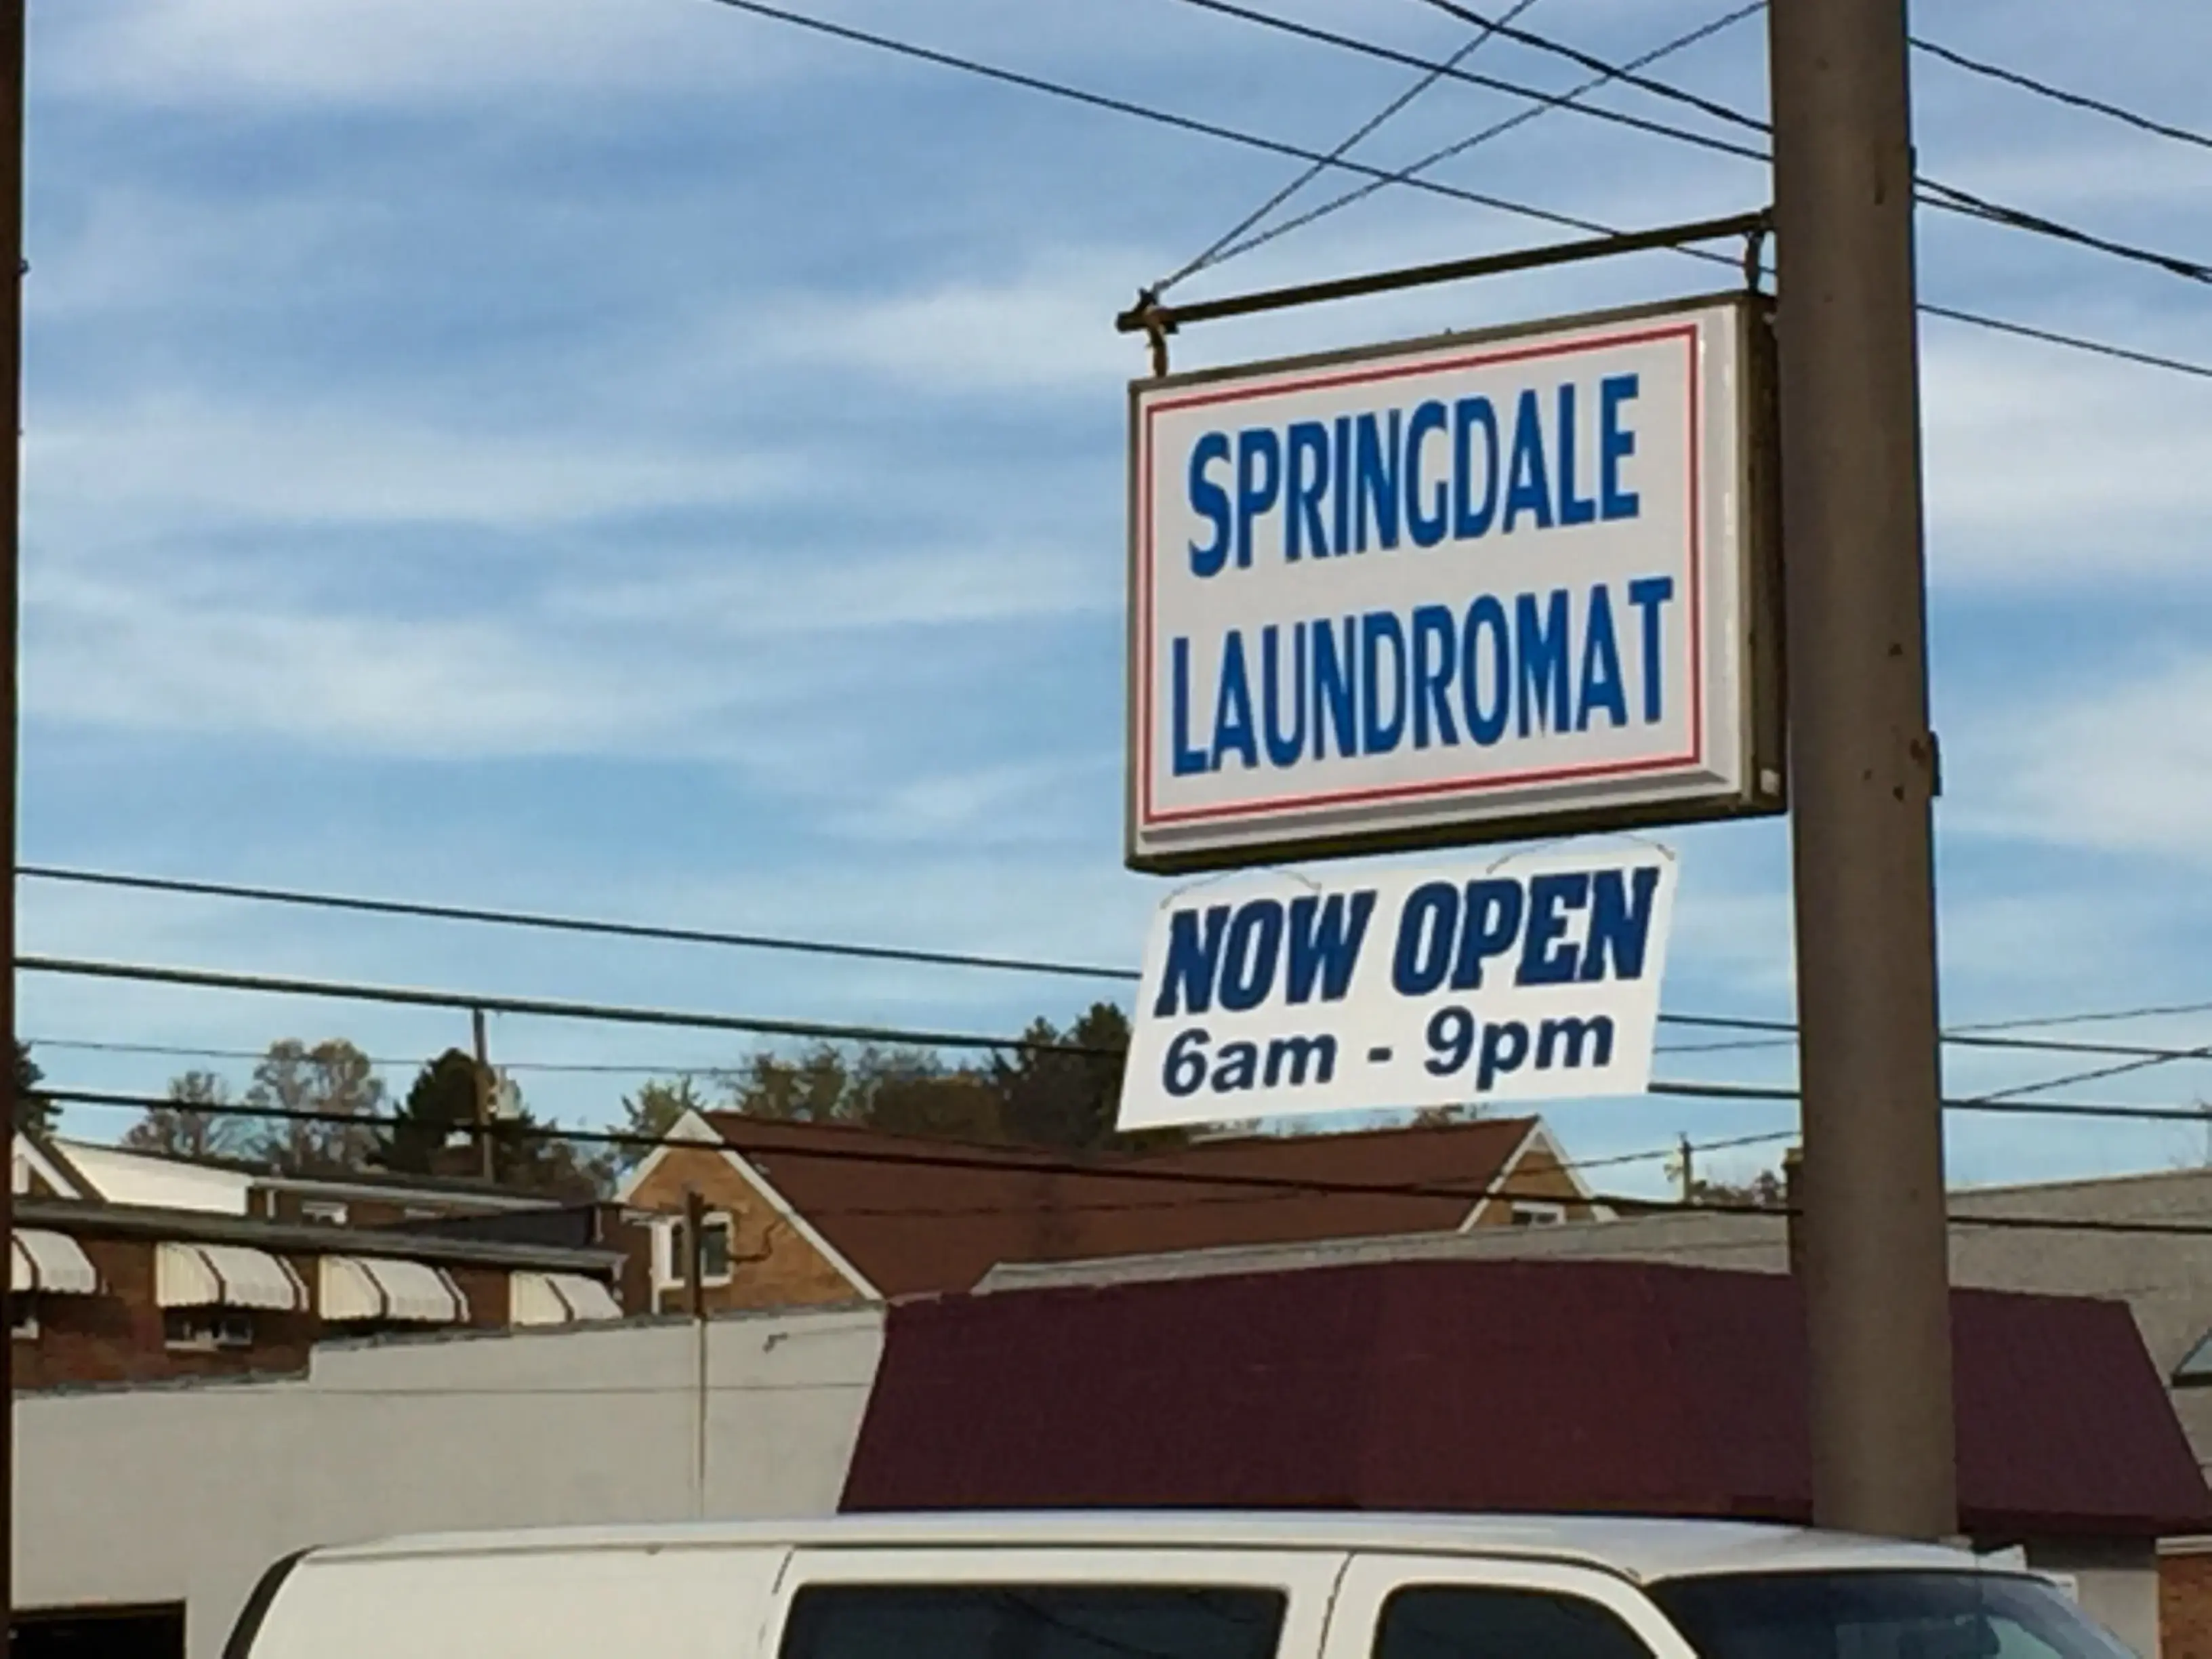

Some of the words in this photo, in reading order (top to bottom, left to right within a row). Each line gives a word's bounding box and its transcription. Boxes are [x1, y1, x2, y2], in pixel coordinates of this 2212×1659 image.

[1188, 372, 1640, 578] SPRINGDALE
[1172, 575, 1674, 777] LAUNDROMAT
[1153, 890, 1378, 1018] NOW
[1392, 866, 1660, 996] OPEN
[1162, 1028, 1337, 1097] 6am
[1368, 1047, 1392, 1062] -
[1425, 1006, 1614, 1092] 9pm
